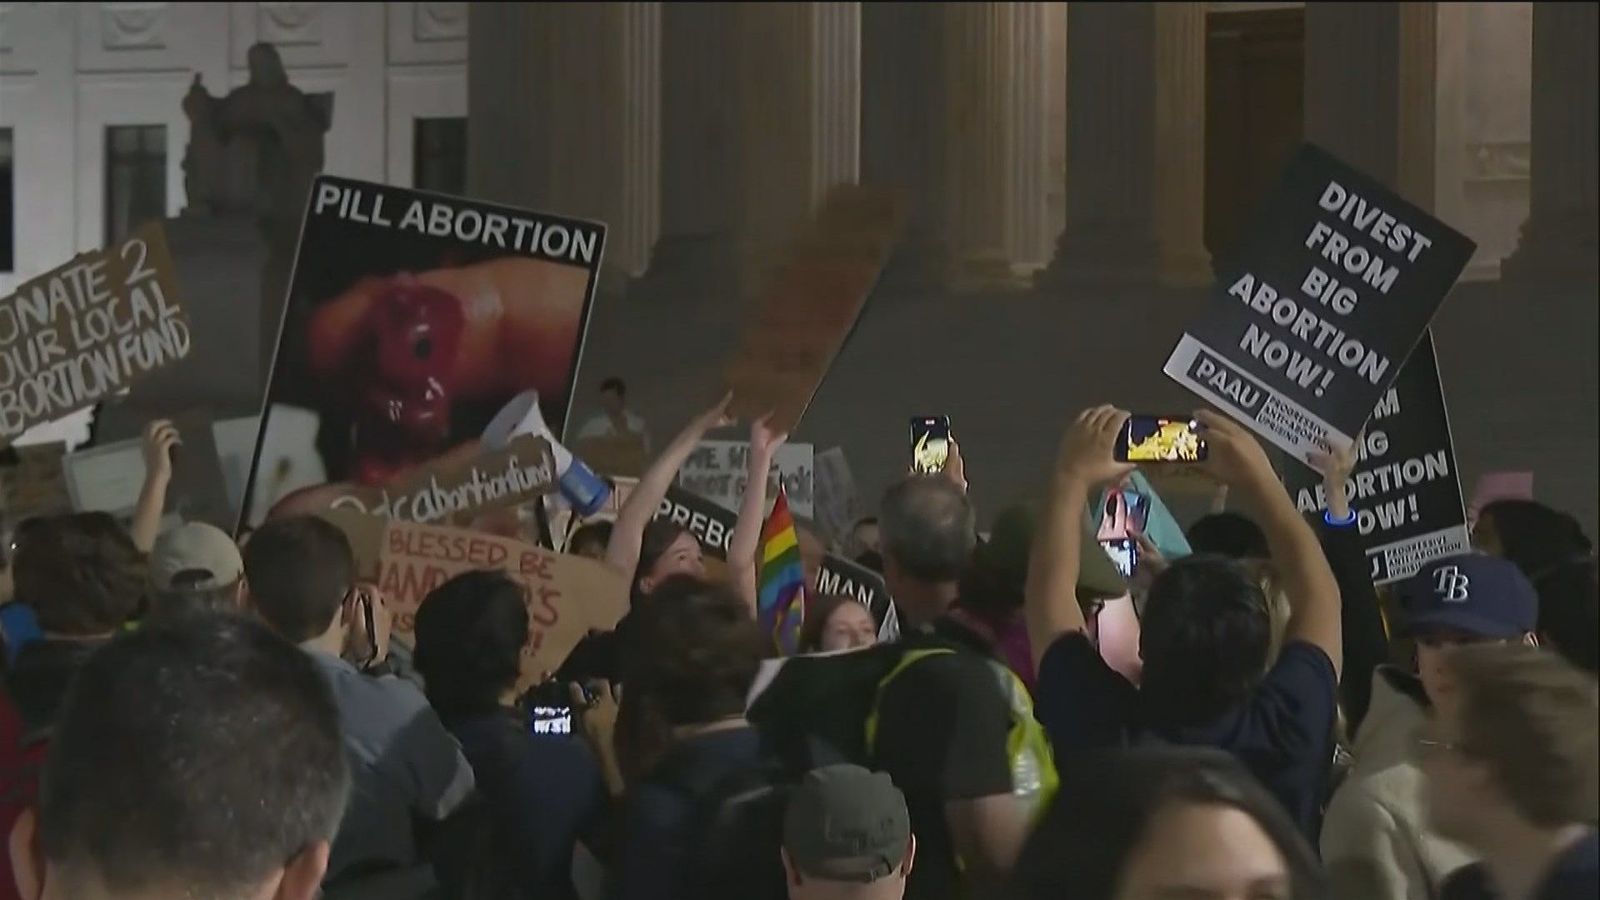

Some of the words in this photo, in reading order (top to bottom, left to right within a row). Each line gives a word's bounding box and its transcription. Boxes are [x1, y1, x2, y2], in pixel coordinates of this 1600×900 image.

[315, 184, 391, 227] PILL
[399, 201, 597, 263] ABORTION
[1319, 181, 1432, 263] DIVEST
[121, 239, 157, 285] 2
[1305, 221, 1399, 294] FROM
[70, 279, 180, 349] LOCAL
[1301, 266, 1358, 315] BIG
[119, 318, 190, 376] FUND
[1228, 272, 1390, 384] ABORTION
[1196, 358, 1260, 408] PAAU
[1239, 323, 1335, 398] NOW!
[1358, 494, 1420, 535] OW!
[390, 529, 507, 565] BLESSED
[520, 551, 556, 580] BE
